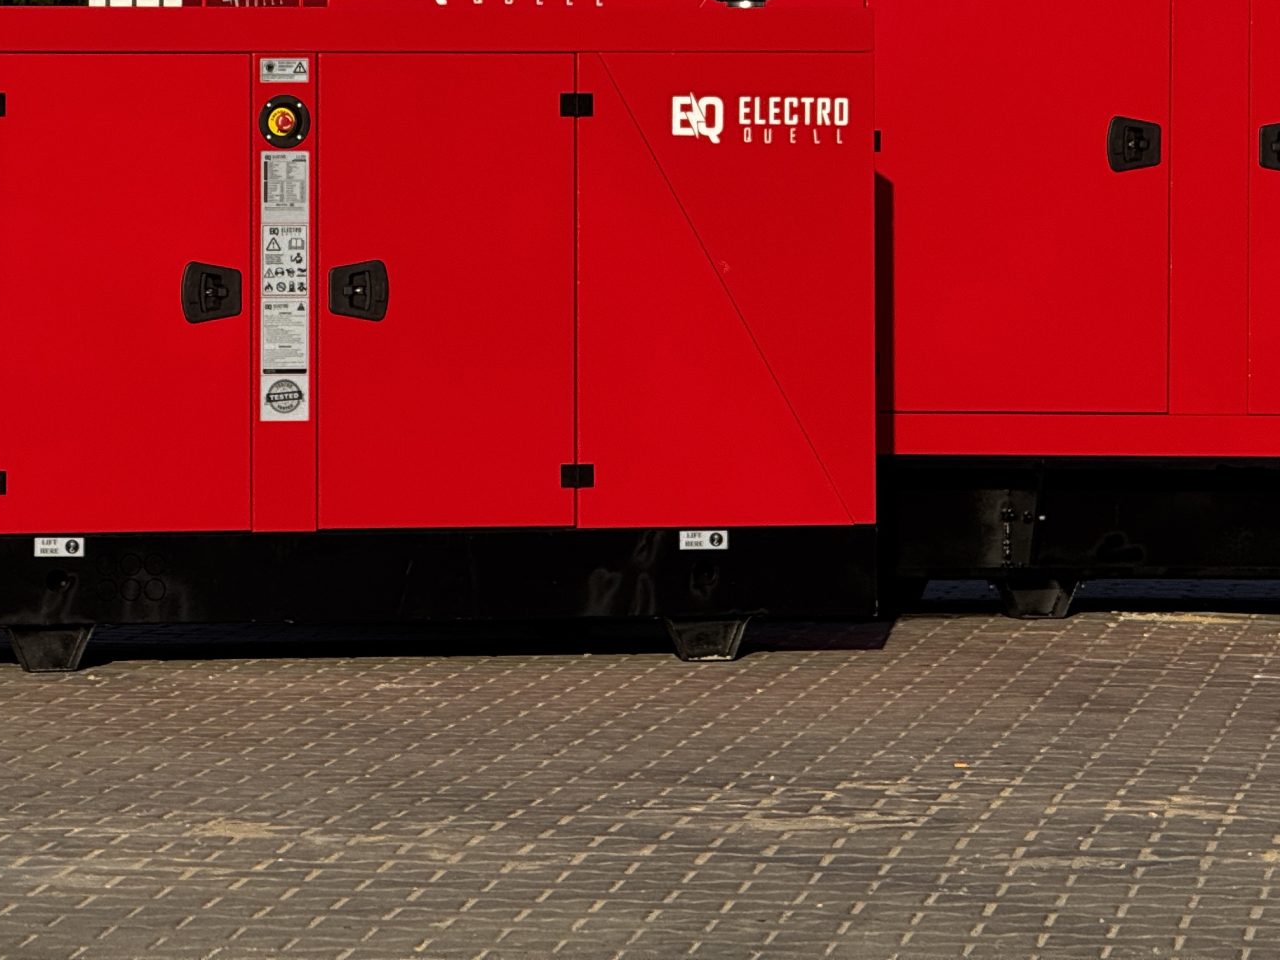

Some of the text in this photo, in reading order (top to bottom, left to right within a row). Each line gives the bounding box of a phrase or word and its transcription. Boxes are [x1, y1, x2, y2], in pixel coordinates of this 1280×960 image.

[672, 92, 724, 144] EQ
[738, 96, 849, 126] ELECTRO
[743, 127, 842, 145] QUELL
[269, 392, 299, 401] TESTED
